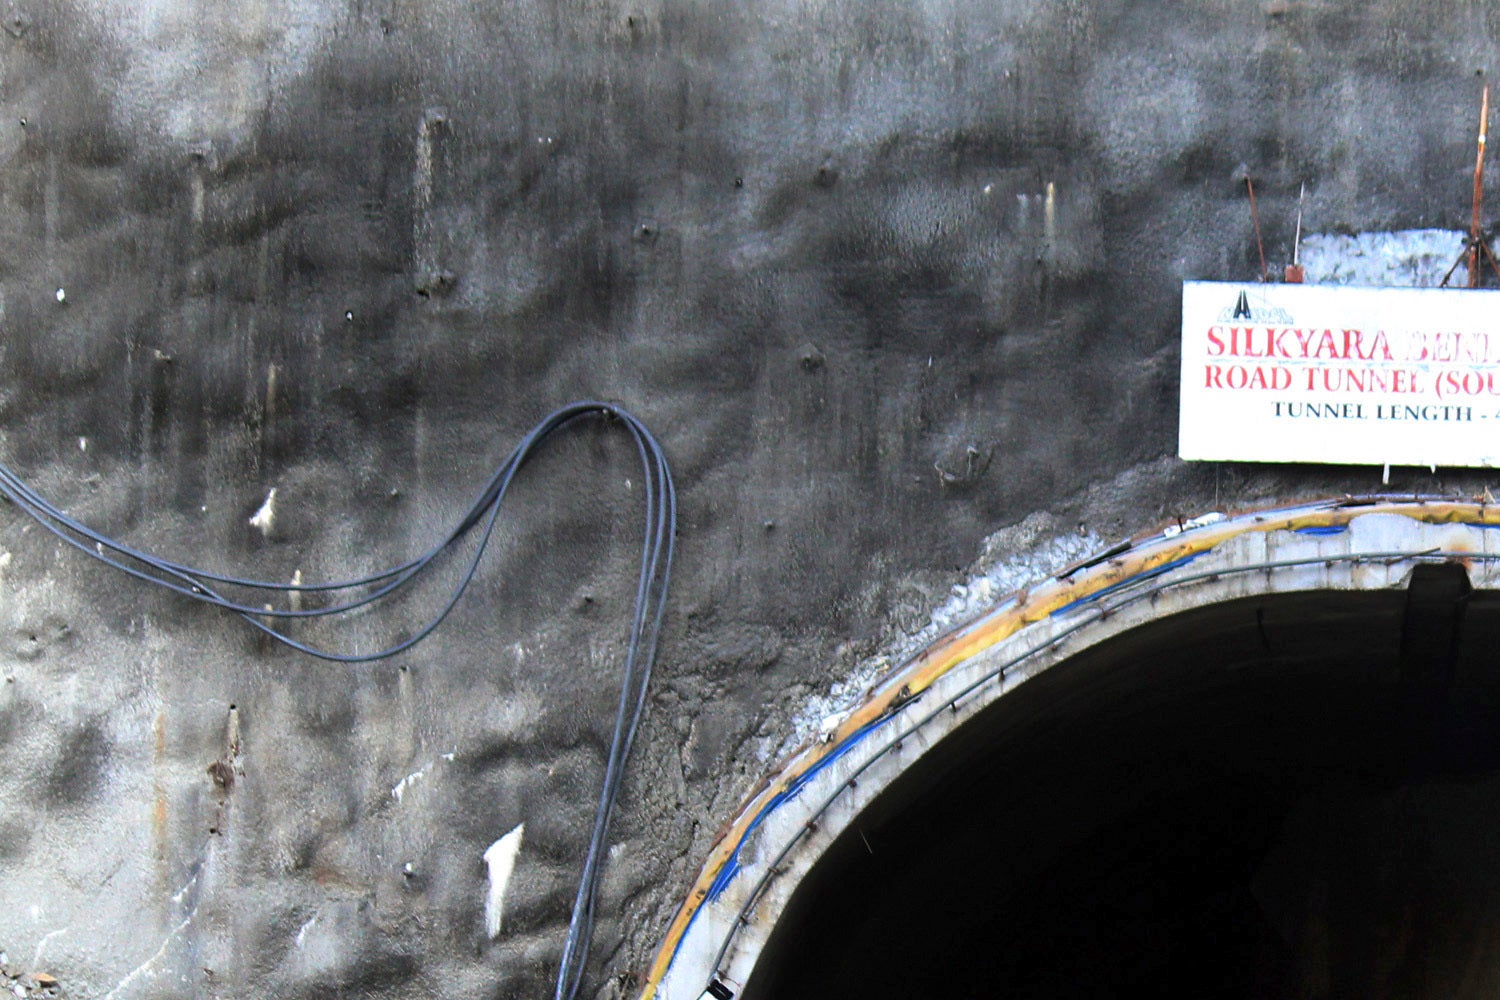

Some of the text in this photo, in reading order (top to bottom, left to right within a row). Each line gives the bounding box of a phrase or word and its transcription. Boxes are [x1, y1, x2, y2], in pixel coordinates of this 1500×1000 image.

[1206, 325, 1394, 361] SILKYARA
[1204, 364, 1292, 391] ROAD
[1302, 367, 1425, 394] TUNNEL
[1272, 401, 1368, 419] TUNNEL
[1376, 404, 1473, 422] LENGTH
